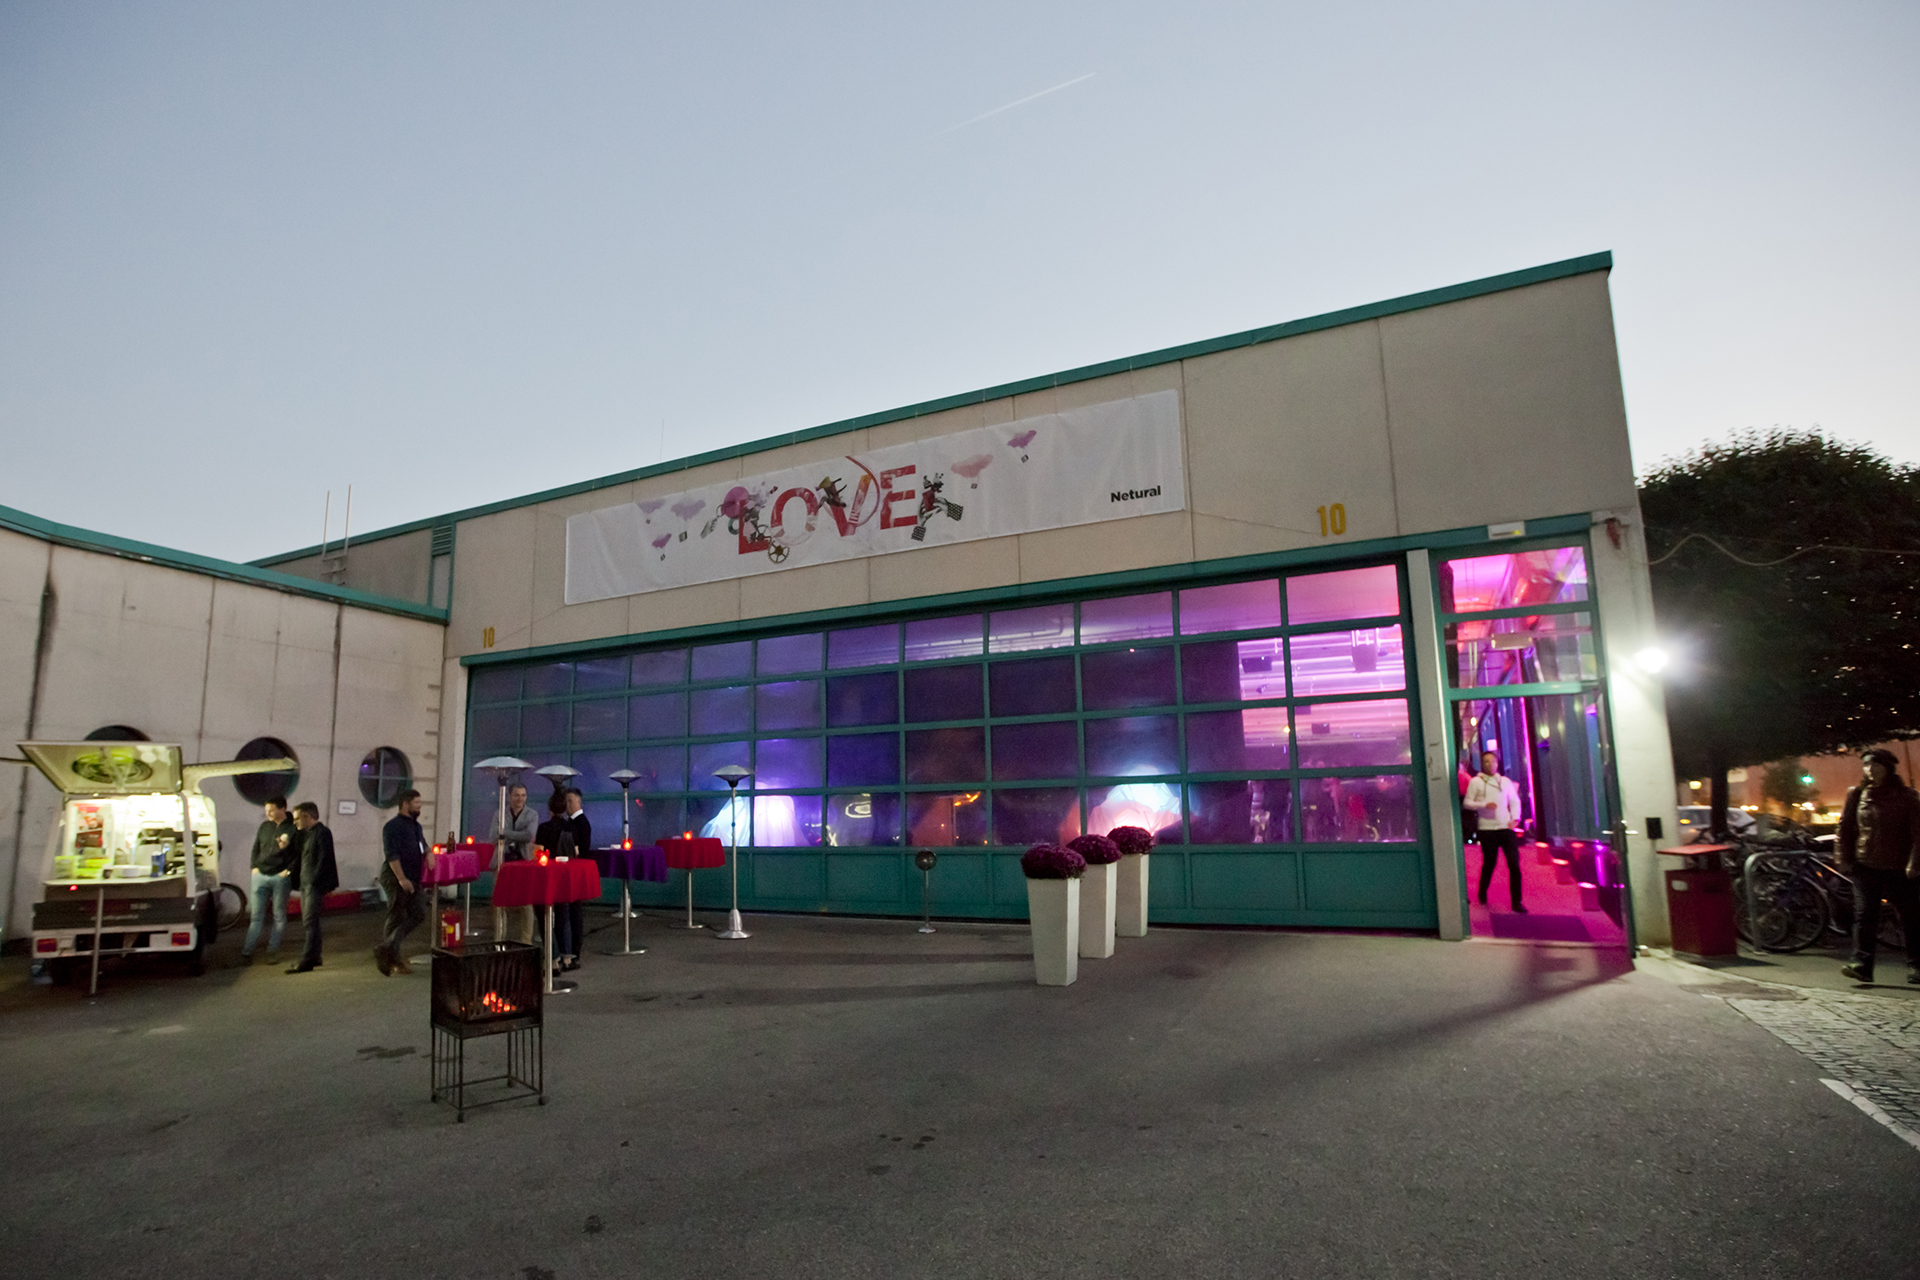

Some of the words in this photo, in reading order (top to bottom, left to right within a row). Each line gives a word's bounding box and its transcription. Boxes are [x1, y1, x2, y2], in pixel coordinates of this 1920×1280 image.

[738, 460, 918, 556] LOVE
[1110, 484, 1161, 503] Netural
[1316, 502, 1346, 537] 10
[482, 626, 495, 649] 10
